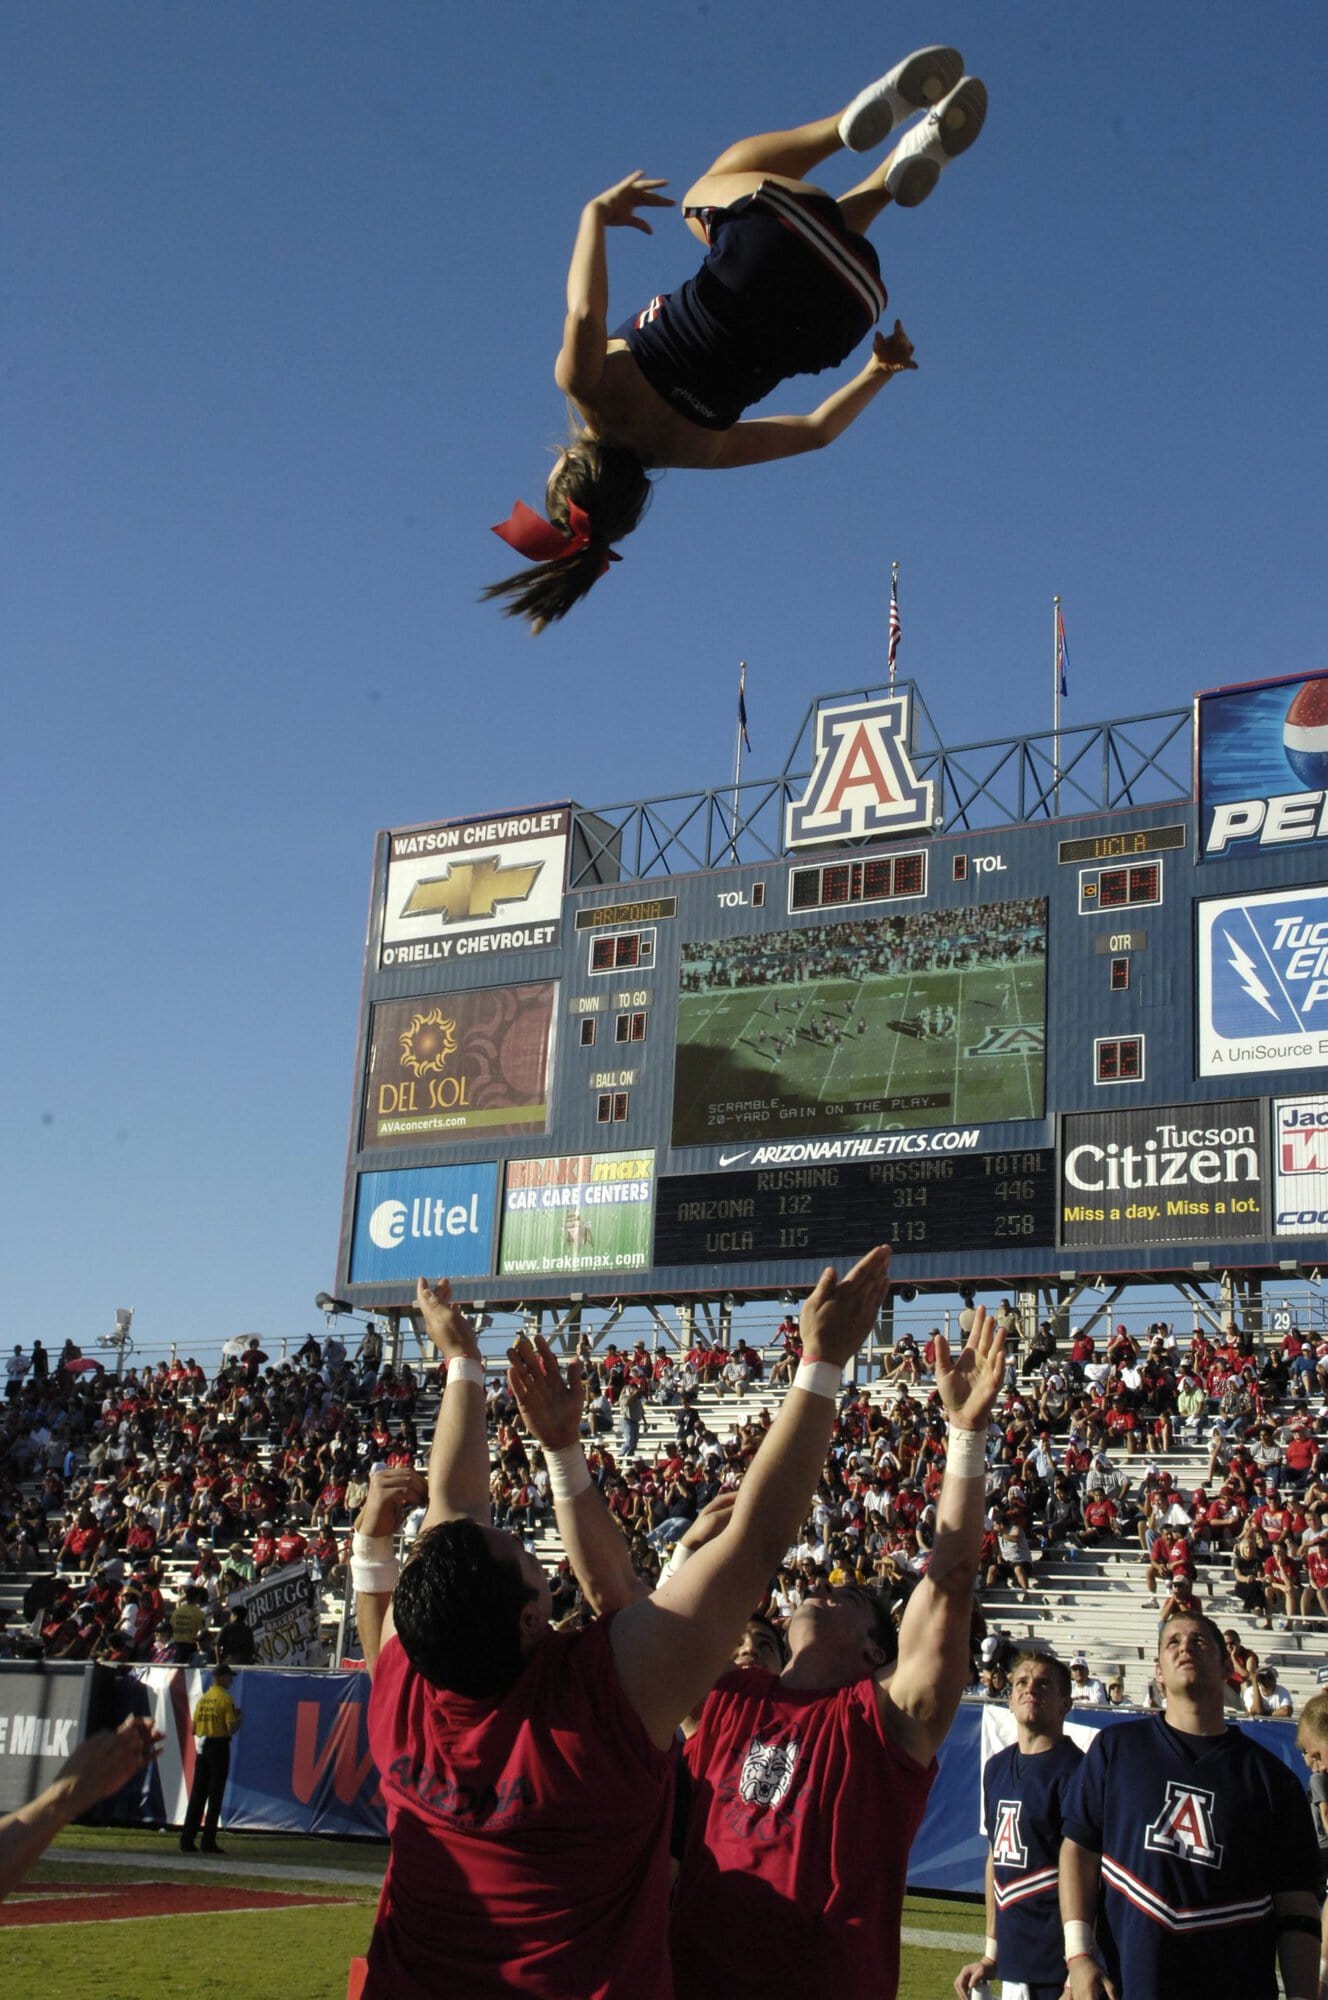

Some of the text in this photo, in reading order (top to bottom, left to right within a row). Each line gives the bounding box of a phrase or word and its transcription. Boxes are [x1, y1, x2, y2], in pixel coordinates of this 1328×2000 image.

[786, 696, 933, 847] A
[394, 813, 562, 855] WATSON CHEVROLET
[1095, 834, 1147, 857] UCLA
[972, 855, 1007, 873] TOL
[717, 891, 748, 908] TOL
[592, 903, 662, 927] ARIZONA
[383, 926, 555, 965] O'RIELLY CHEVROLET
[1110, 934, 1131, 951] QTR
[1272, 916, 1328, 950] Tuc
[579, 996, 599, 1012] DWN
[619, 991, 646, 1008] TO GO
[1211, 1049, 1223, 1063] A
[1229, 1043, 1312, 1062] UniSource
[596, 1071, 633, 1088] BALL ON
[379, 1076, 470, 1114] DEL SOL
[708, 1098, 786, 1114] SCRAMBLE.
[380, 1115, 466, 1134] AVAconcerts.com
[708, 1097, 937, 1126] 20-YARD GAIN ON THE PLAY.
[751, 1130, 980, 1165] ARIZONAATHLETICS.COM
[1156, 1125, 1256, 1149] Tucson
[508, 1157, 653, 1188] BRAKE max
[757, 1153, 1047, 1192] RUSHING PASSING TOTAL
[1065, 1139, 1260, 1191] Citizen
[508, 1182, 649, 1210] CAR CARE CENTERS
[678, 1180, 1035, 1222] ARIZONA 132 314 446
[1064, 1198, 1260, 1222] Miss a day. Miss a lot.
[370, 1194, 478, 1248] alltel
[705, 1215, 1034, 1252] UCLA 115 113 258
[504, 1252, 645, 1272] www.brakemax.com
[1274, 1312, 1290, 1330] 29
[9, 1715, 78, 1757] MILK
[993, 1799, 1028, 1869] A
[1144, 1780, 1224, 1870] A
